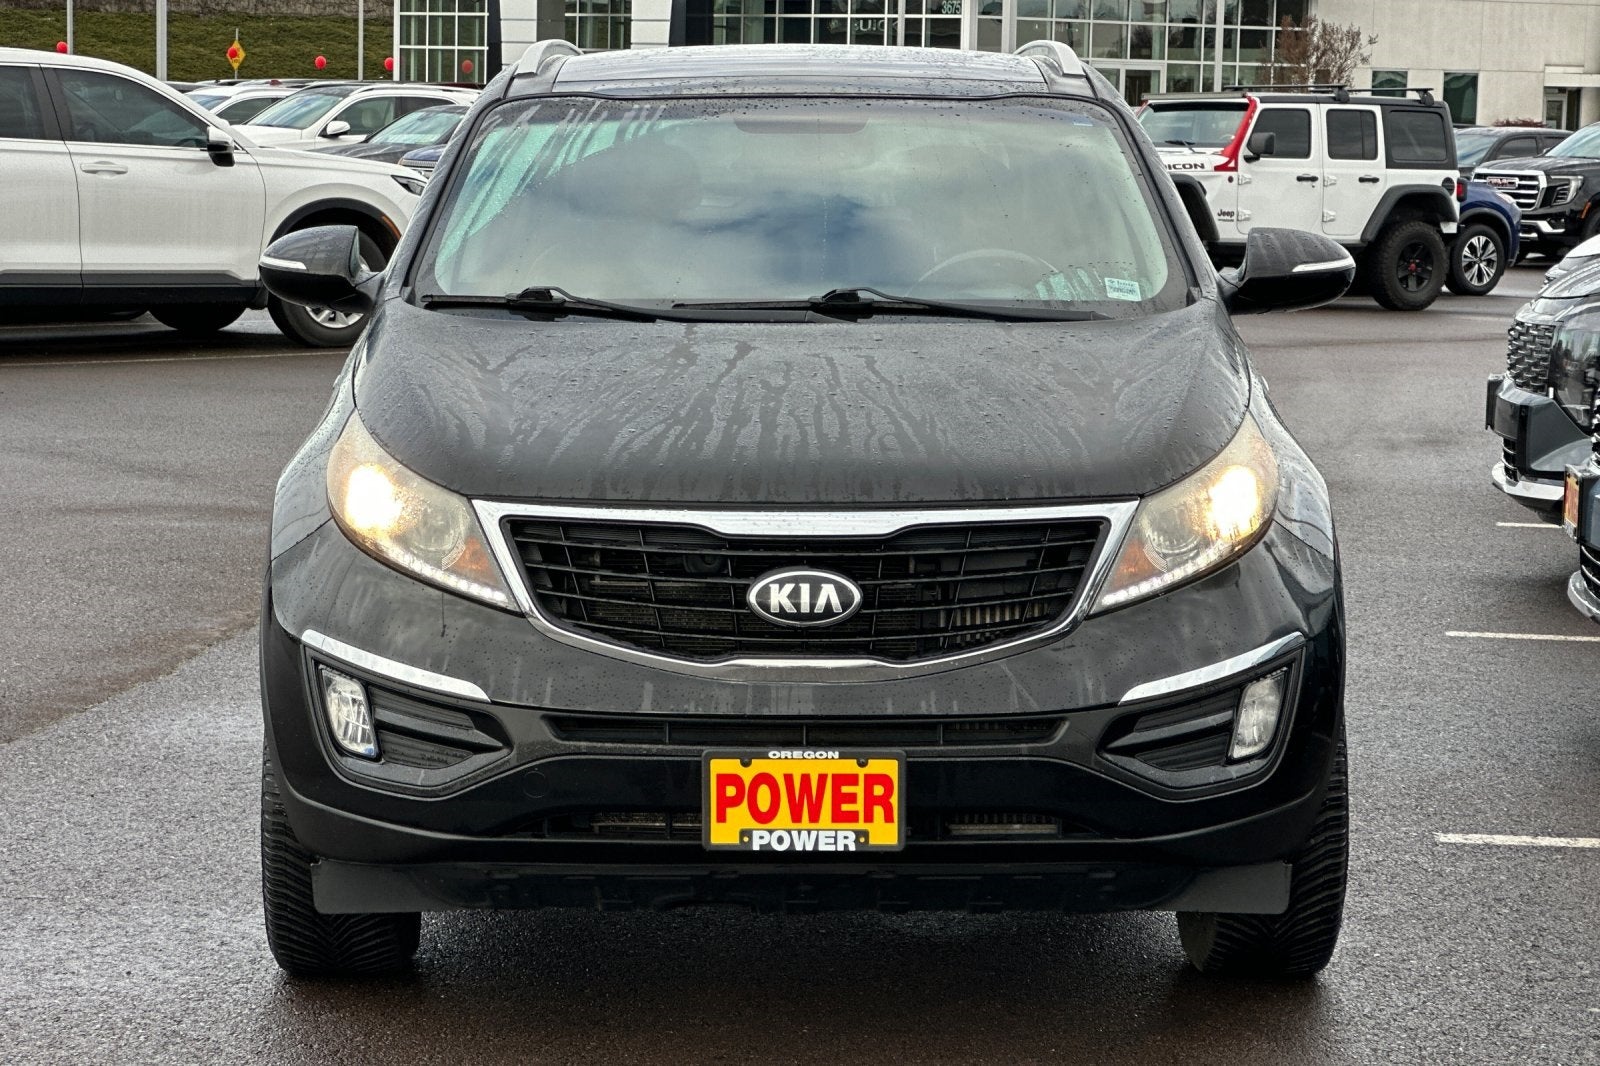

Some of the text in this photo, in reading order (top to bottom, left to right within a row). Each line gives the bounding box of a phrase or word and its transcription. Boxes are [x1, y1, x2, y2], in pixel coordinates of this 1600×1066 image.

[941, 0, 961, 14] 3675
[1164, 163, 1205, 171] ICON
[1217, 209, 1235, 218] Jeep
[769, 583, 842, 613] KIA
[768, 751, 840, 759] OREGON
[716, 772, 895, 824] POWER
[752, 830, 856, 851] POWER
